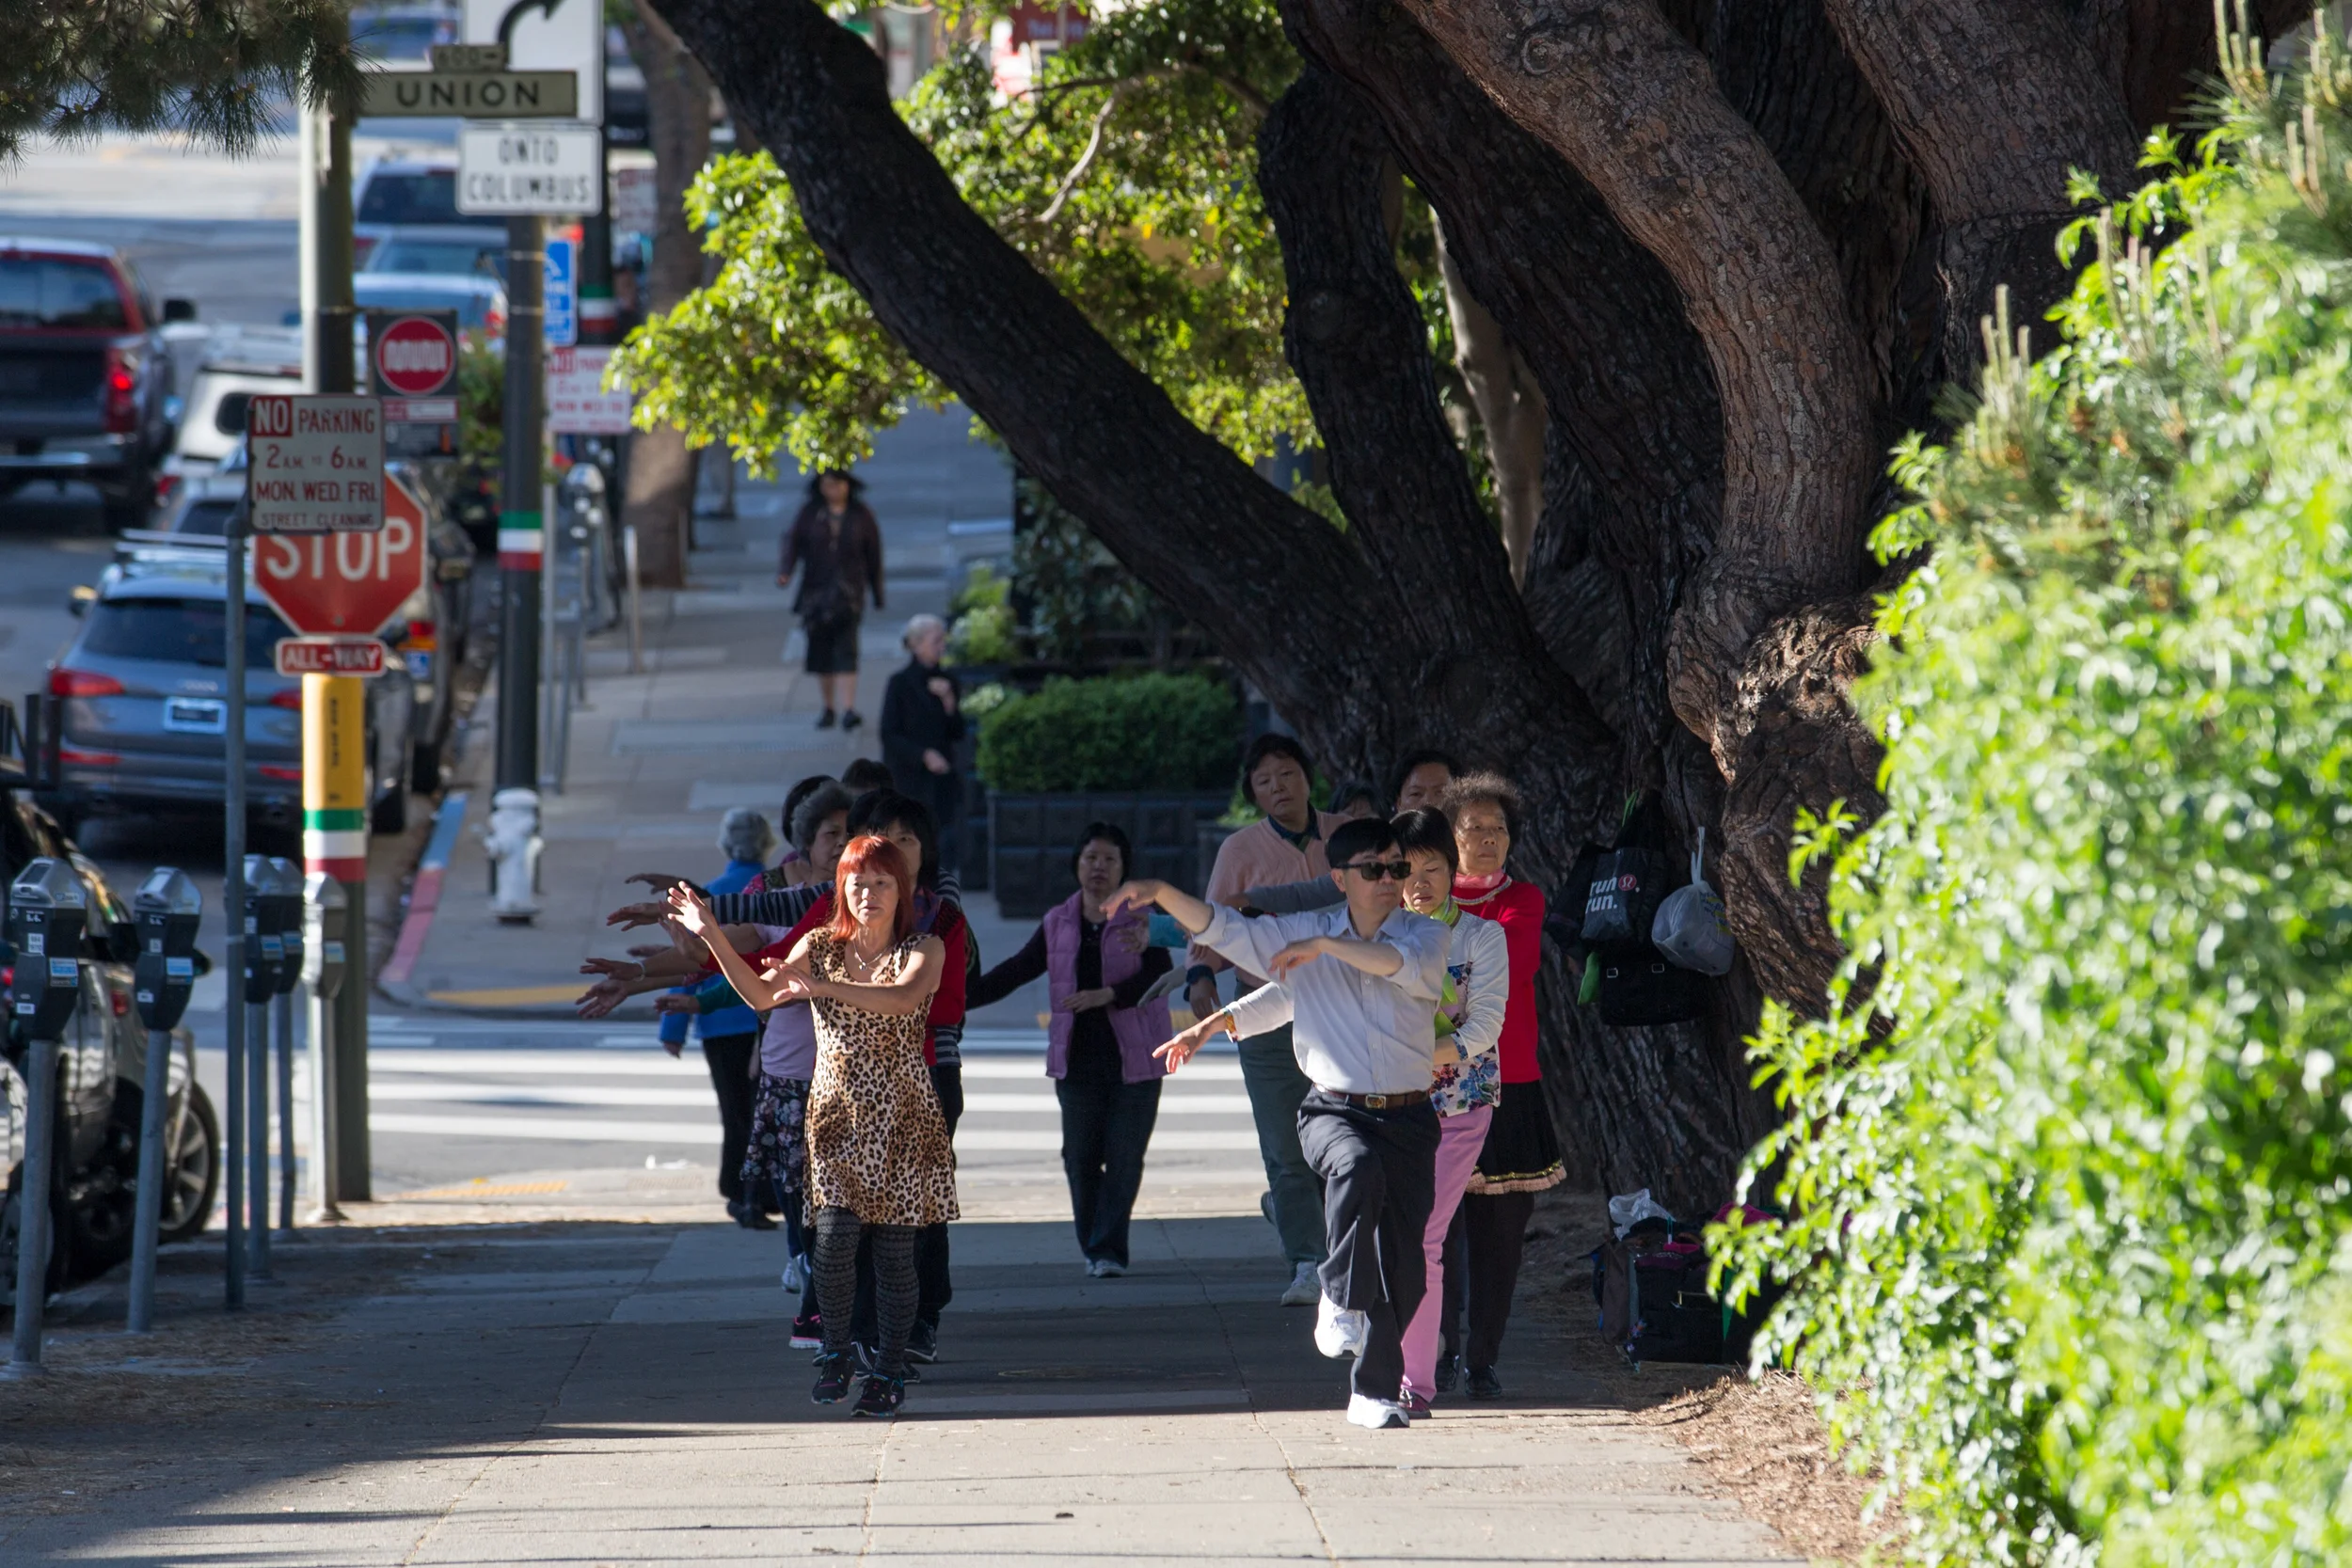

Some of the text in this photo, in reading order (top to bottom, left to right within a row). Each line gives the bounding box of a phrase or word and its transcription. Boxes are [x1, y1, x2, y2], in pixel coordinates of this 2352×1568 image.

[395, 80, 540, 107] UNION
[499, 135, 559, 166] ONTO
[469, 173, 590, 202] COLUMBUS
[255, 399, 290, 434] NO
[298, 408, 375, 434] PARKING
[262, 513, 374, 526] STREET CLEANING
[285, 648, 380, 669] ALL-WAY
